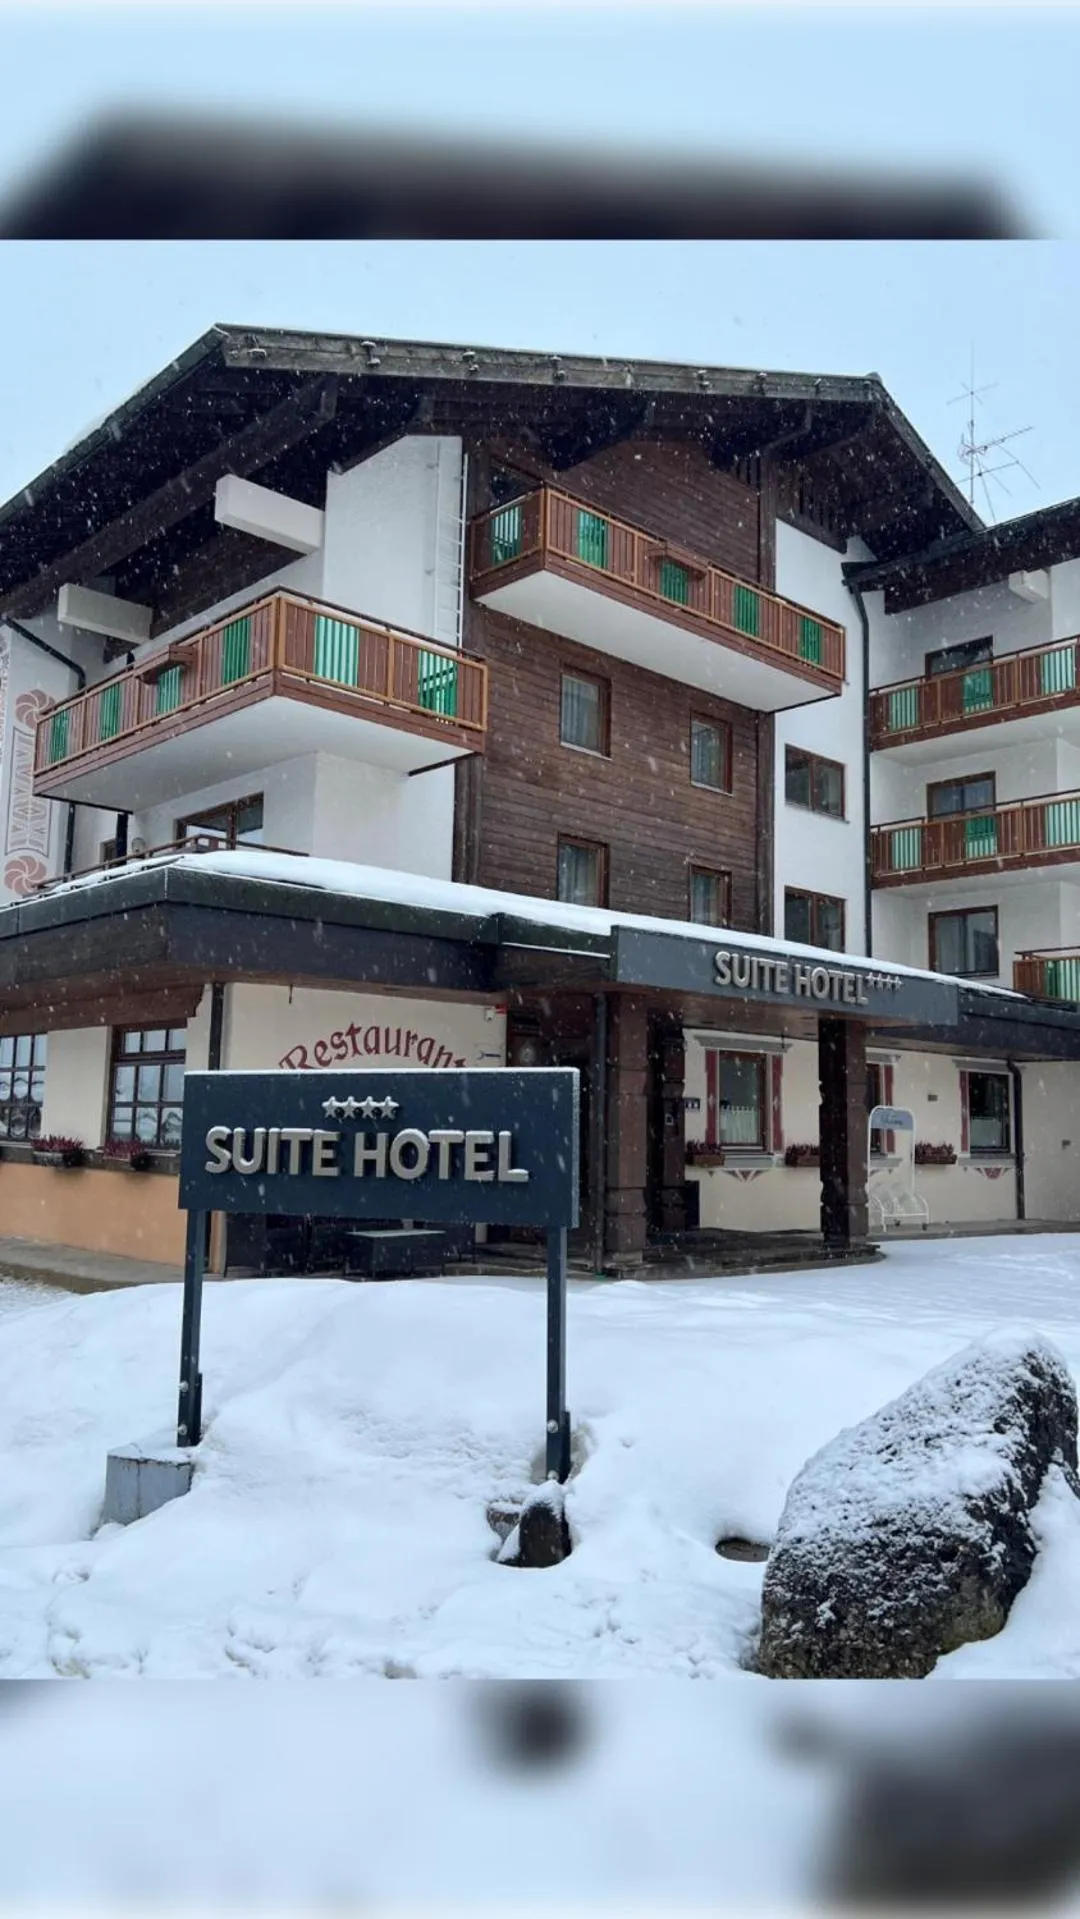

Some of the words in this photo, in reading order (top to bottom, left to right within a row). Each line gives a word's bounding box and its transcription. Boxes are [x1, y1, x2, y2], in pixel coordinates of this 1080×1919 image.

[715, 951, 790, 994] SUITE
[794, 964, 869, 1005] HOTEL
[278, 1021, 467, 1069] Restauran
[204, 1126, 341, 1177] SUITE
[353, 1128, 529, 1182] HOTEL
